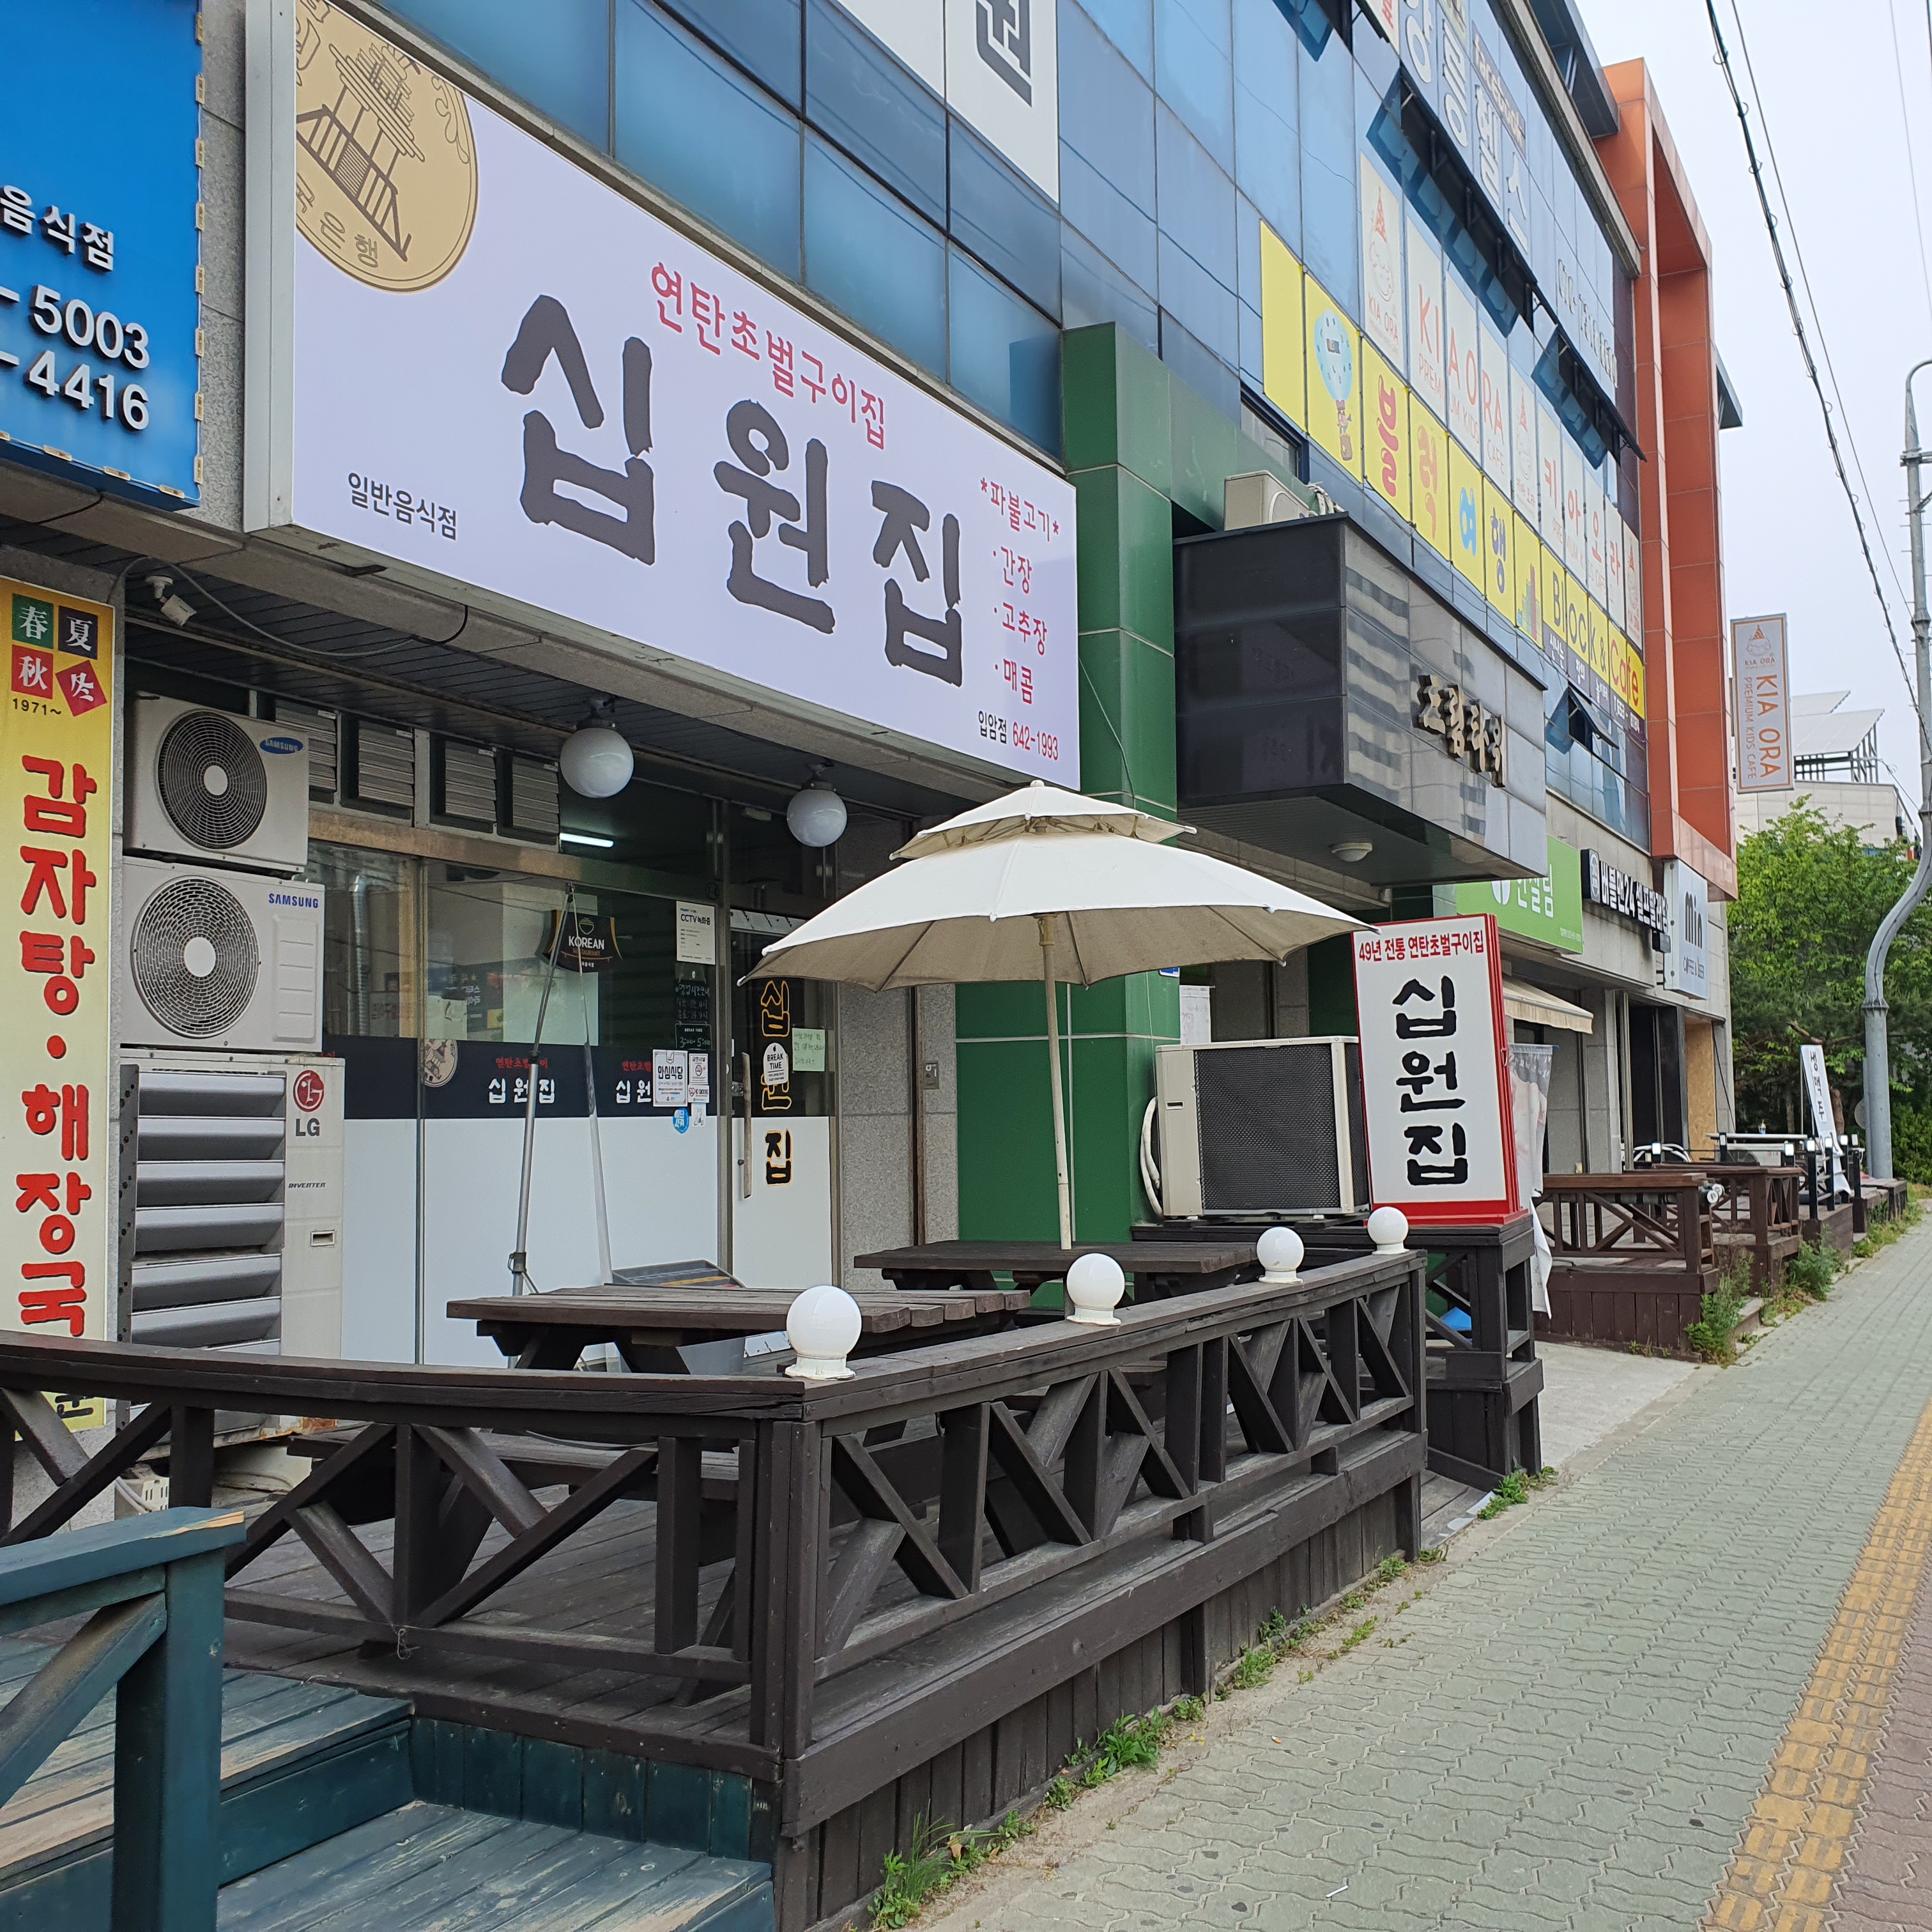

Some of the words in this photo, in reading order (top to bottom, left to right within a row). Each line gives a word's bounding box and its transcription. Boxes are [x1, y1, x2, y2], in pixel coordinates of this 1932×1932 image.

[0, 184, 114, 273] 음식점
[650, 261, 885, 451] 연탄초벌구이집
[1418, 283, 1460, 390] KIA
[1466, 349, 1505, 446] ORA
[347, 471, 458, 541] 일반음식점
[501, 295, 963, 687] 십원집
[1544, 456, 1621, 587] 키아오라
[1552, 571, 1597, 665] Block
[1600, 636, 1607, 674] &
[1610, 639, 1639, 707] Cafe
[12, 698, 62, 716] 1971~
[1744, 677, 1754, 723] PREMIUM
[1756, 674, 1779, 717] KIA
[264, 739, 299, 753] SAMSUNG
[977, 710, 1008, 744] 입암점
[1013, 721, 1059, 761] 642-1993
[1745, 726, 1755, 750] KIDS
[1747, 753, 1757, 779] CAFE
[1758, 728, 1782, 778] ORA
[268, 893, 319, 908] SAMSUNG
[680, 914, 697, 923] CCTV
[1684, 891, 1703, 949] min
[568, 935, 605, 950] KOREAN
[1358, 940, 1382, 963] 49년
[1384, 937, 1406, 961] 전통
[1408, 929, 1484, 959] 연탄초벌구이집
[496, 1055, 548, 1070] 연탄초벌이
[767, 1052, 784, 1062] BREAK
[769, 1061, 783, 1070] TIME
[657, 1065, 684, 1080] 안심식당
[1392, 975, 1468, 1186] 십원집
[488, 1078, 555, 1104] 십원집
[615, 1079, 652, 1104] 십원
[295, 1117, 320, 1137] LG
